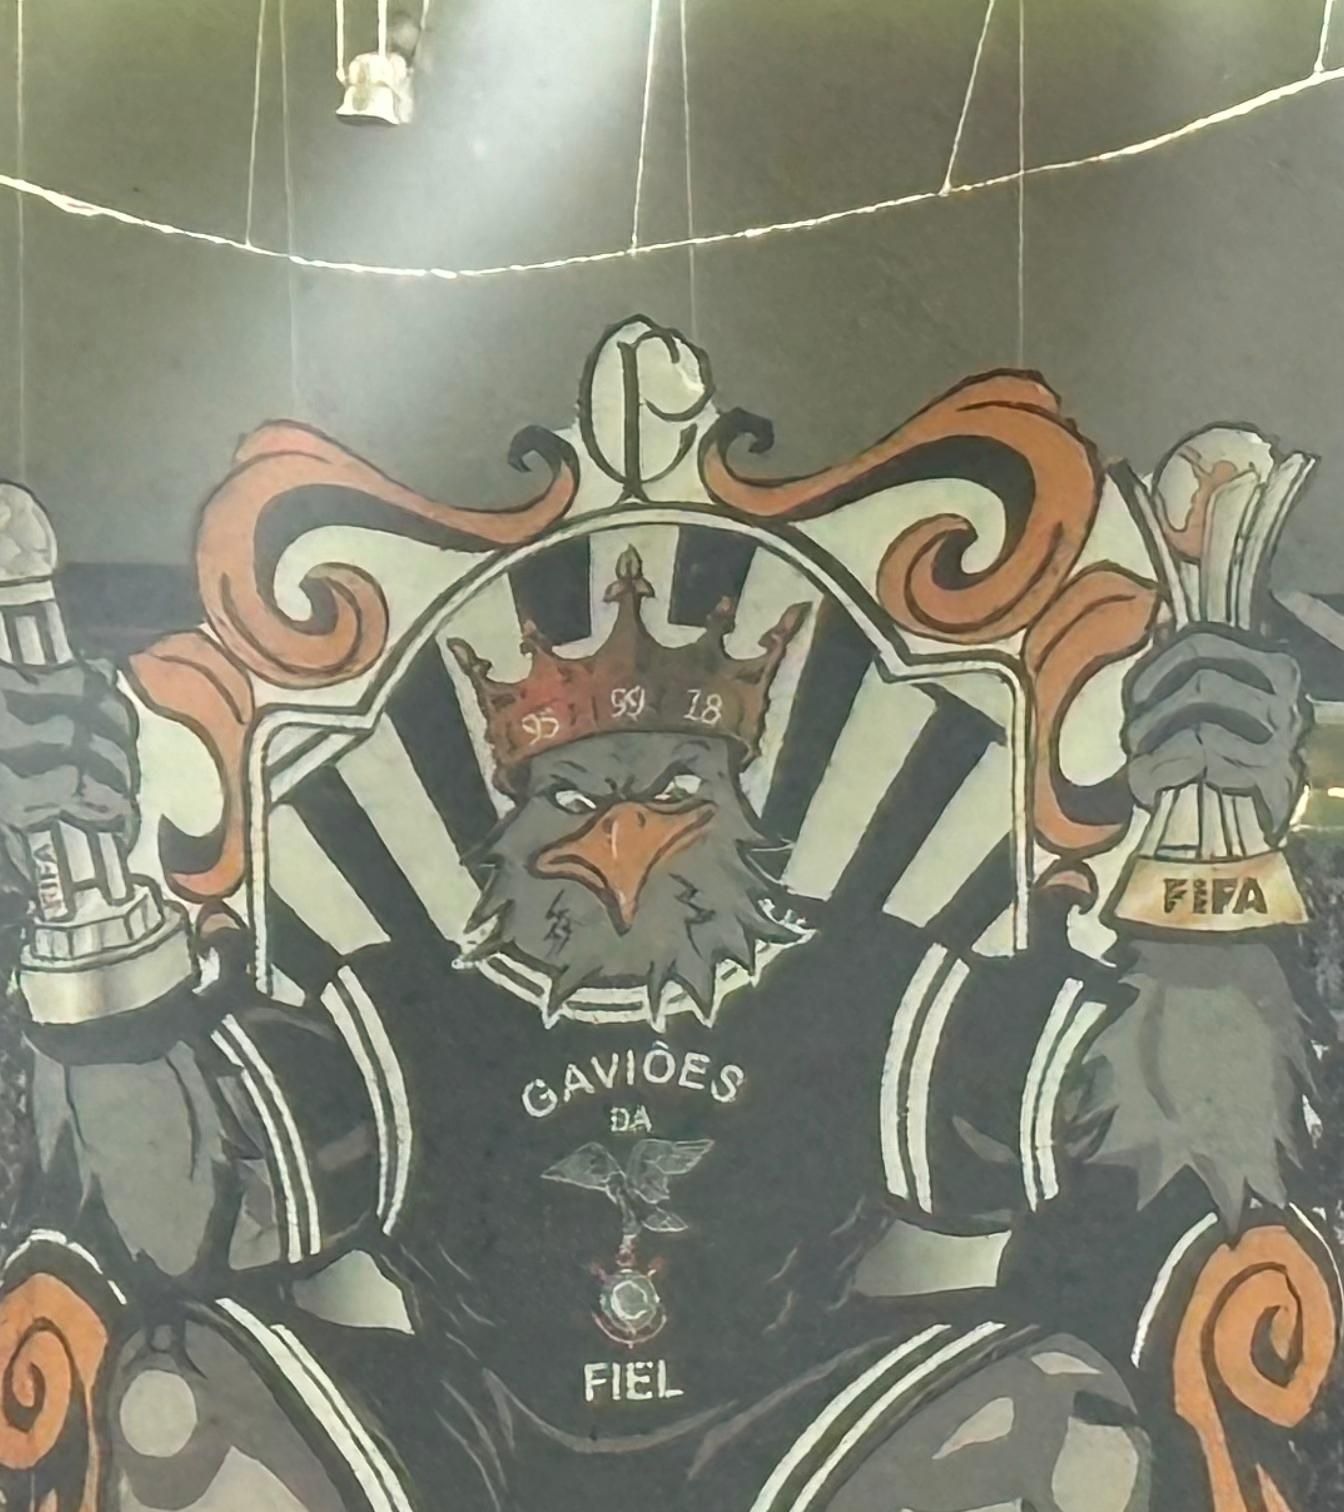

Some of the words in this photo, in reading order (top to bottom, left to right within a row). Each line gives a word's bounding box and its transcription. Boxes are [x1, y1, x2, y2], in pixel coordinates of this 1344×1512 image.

[683, 689, 722, 727] 18
[1163, 877, 1269, 914] FIFA
[610, 1104, 652, 1133] DA
[583, 1358, 685, 1402] FIEL
